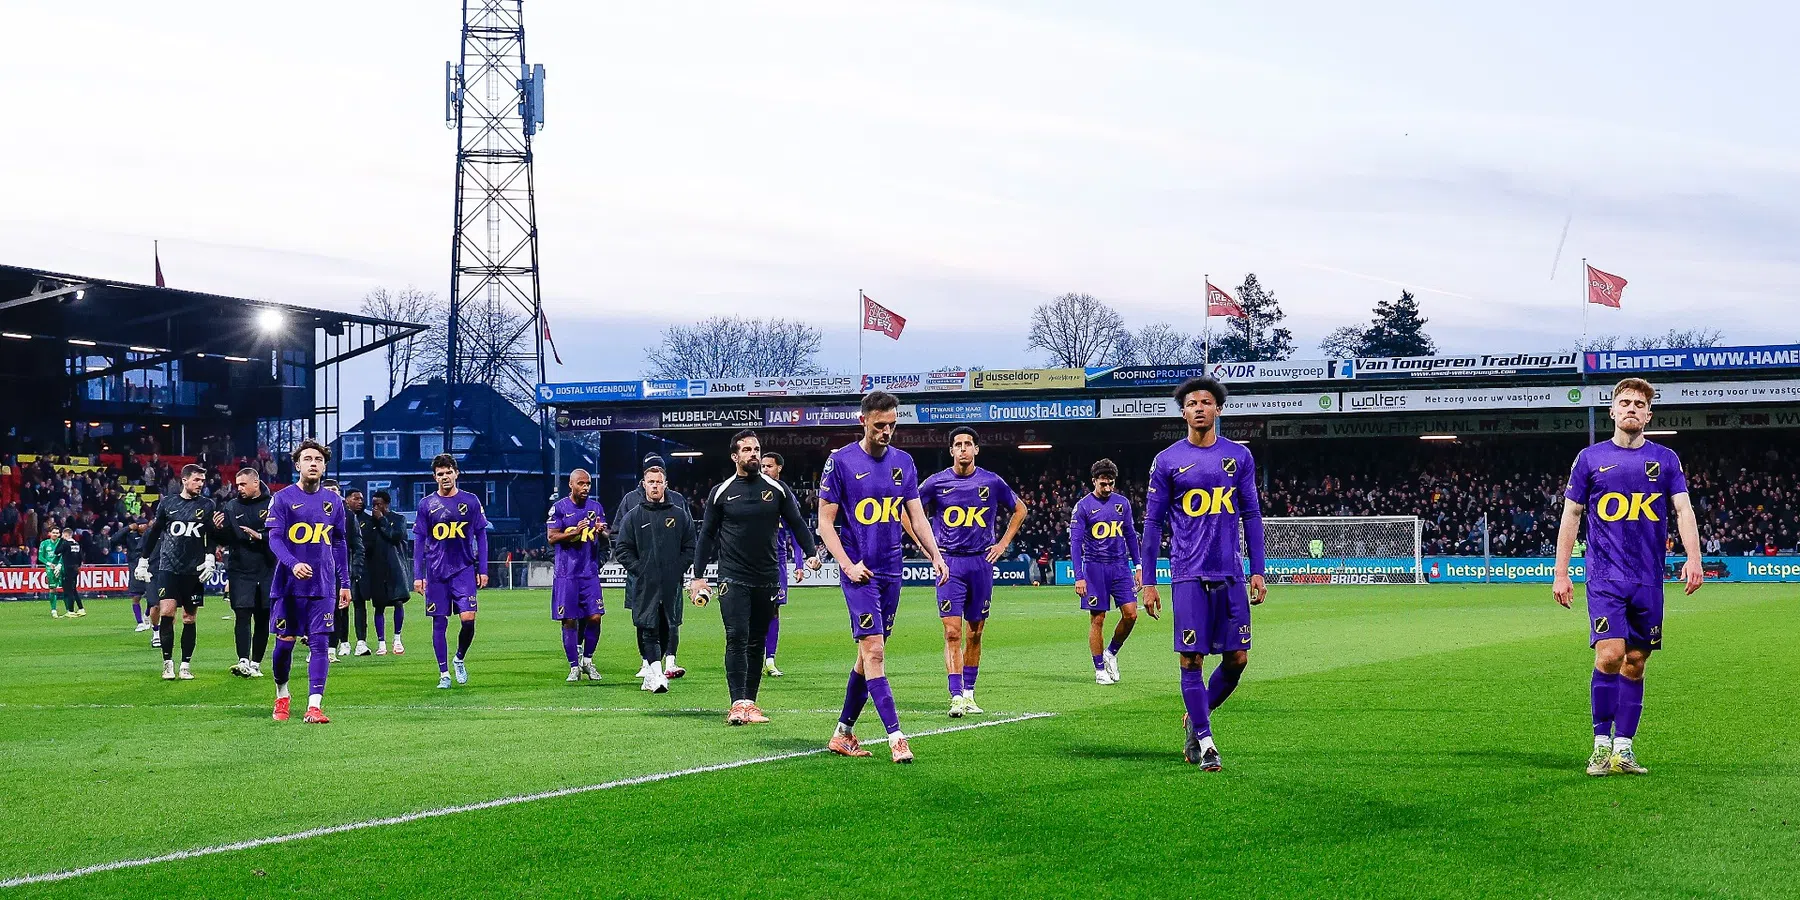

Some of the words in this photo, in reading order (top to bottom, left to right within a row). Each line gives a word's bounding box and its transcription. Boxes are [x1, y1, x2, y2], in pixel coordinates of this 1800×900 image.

[1355, 359, 1388, 370] Van
[1391, 357, 1476, 371] Tongeren
[1480, 352, 1578, 367] Trading.nl
[1599, 353, 1687, 370] Hamer
[1692, 350, 1800, 367] WWW.HAME
[875, 375, 920, 384] BEEKMAN
[986, 372, 1040, 382] dusseldorp
[1113, 369, 1202, 380] ROOFINGPROJECTS
[1227, 364, 1256, 378] VDR
[1260, 366, 1324, 380] Bouwgroep
[586, 385, 637, 394] WEGENBOUW
[710, 383, 745, 393] Abbott
[788, 377, 852, 387] ADVISEURS
[886, 380, 918, 390] elektro
[1352, 394, 1407, 407] wolters
[1444, 396, 1464, 404] zorg
[1507, 393, 1551, 402] vastgoed
[1702, 389, 1724, 397] zorg
[1727, 388, 1749, 396] voor
[1113, 400, 1167, 413] wolters
[1262, 400, 1303, 409] vastgoed
[768, 410, 800, 423] JANS
[805, 411, 861, 420] UITZENDBUR
[1182, 486, 1236, 517] OK
[1597, 492, 1662, 522] OK
[855, 497, 904, 525] OK
[943, 505, 990, 528] OK
[170, 521, 204, 538] OK
[288, 522, 334, 545] OK
[432, 521, 469, 541] OK
[1091, 520, 1124, 539] OK
[1747, 562, 1800, 578] hetspe
[1331, 574, 1377, 584] BRIDGE
